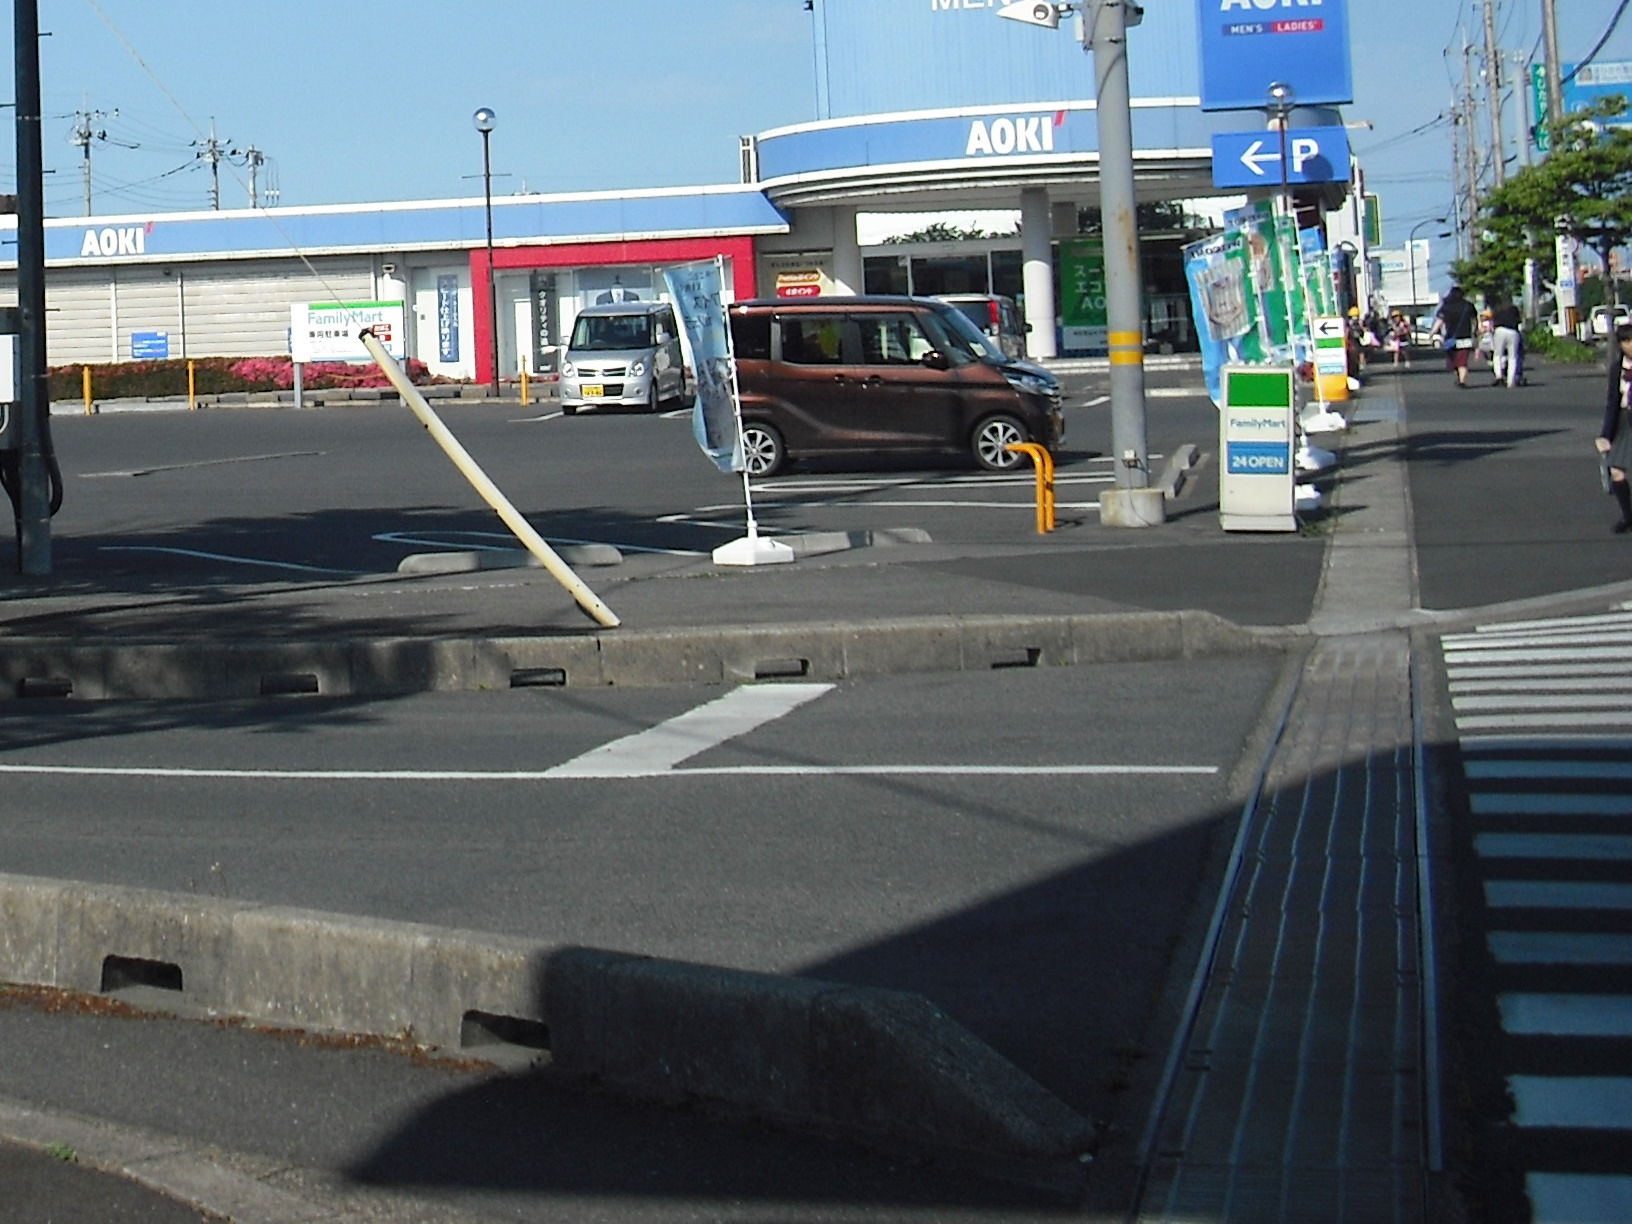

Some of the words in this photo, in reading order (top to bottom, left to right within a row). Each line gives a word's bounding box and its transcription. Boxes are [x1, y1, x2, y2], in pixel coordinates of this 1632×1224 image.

[1230, 24, 1264, 34] MEN'S
[966, 116, 1054, 155] AOKI
[1292, 138, 1320, 173] P
[80, 227, 145, 257] AOKI
[308, 310, 383, 327] FamilyMart
[1230, 418, 1285, 429] FamilyMart
[1248, 456, 1284, 468] OPEN
